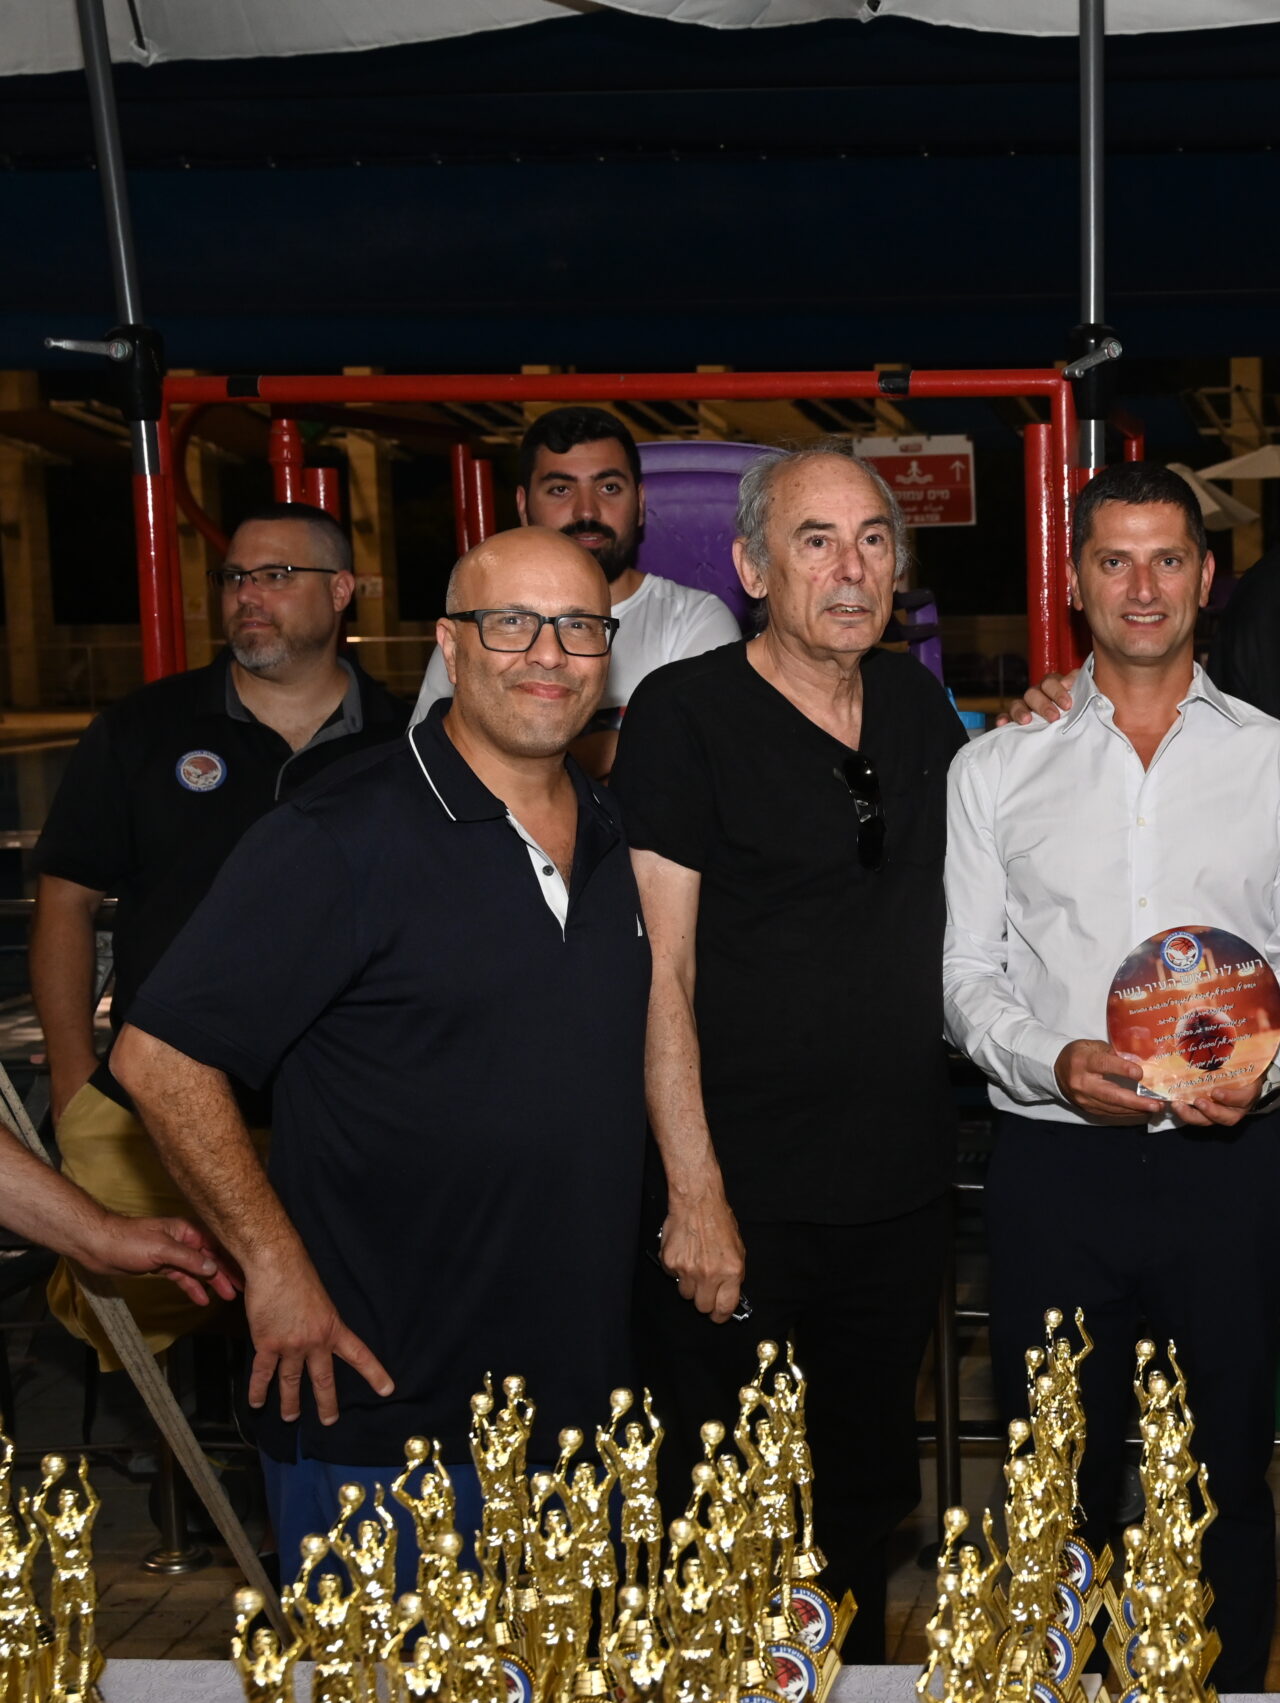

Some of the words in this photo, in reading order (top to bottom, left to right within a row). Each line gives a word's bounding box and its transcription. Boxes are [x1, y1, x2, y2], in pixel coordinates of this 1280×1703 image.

[1214, 963, 1233, 977] לוי
[1145, 978, 1176, 993] העיר
[1180, 970, 1212, 986] ראש
[1114, 985, 1142, 1000] נשר
